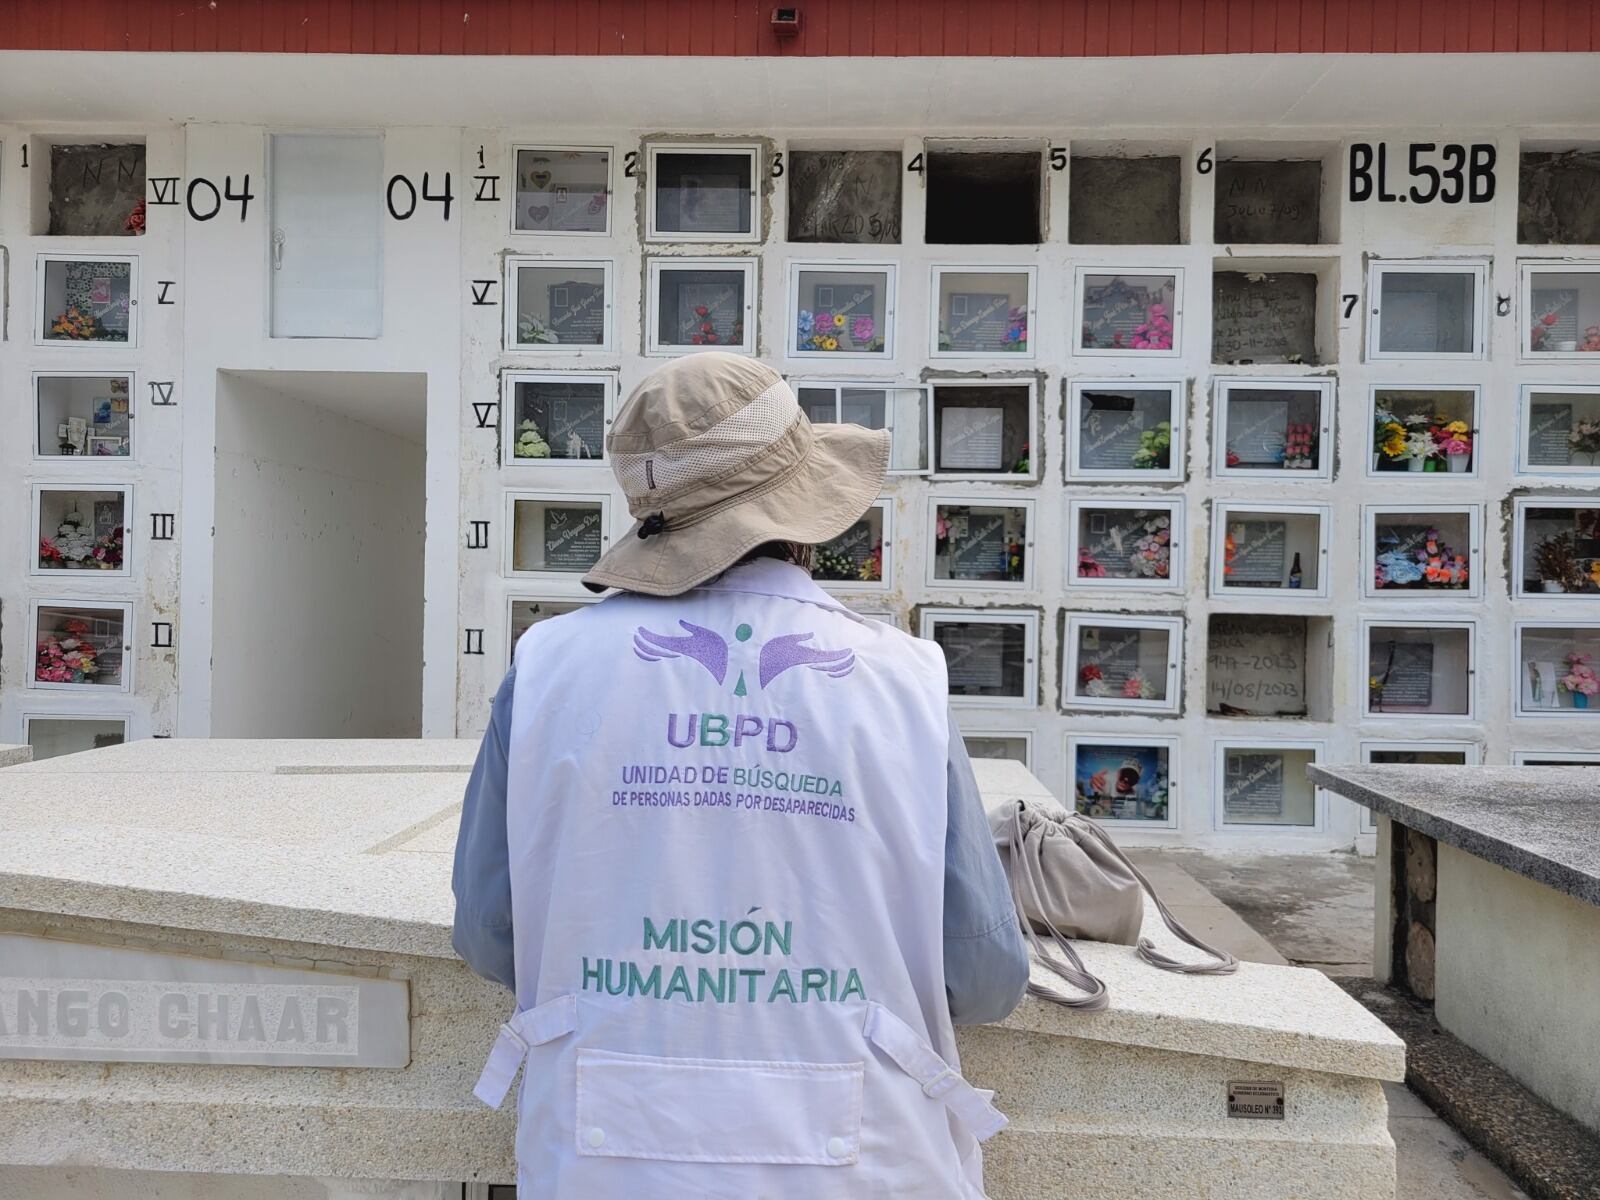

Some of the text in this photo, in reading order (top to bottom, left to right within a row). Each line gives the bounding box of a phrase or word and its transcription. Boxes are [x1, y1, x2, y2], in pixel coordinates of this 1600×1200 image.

[20, 144, 29, 168] 1
[624, 151, 638, 177] 2
[771, 152, 784, 178] 3
[907, 152, 924, 176] 4
[1050, 147, 1067, 171] 5
[1196, 147, 1213, 175] 6
[1349, 142, 1497, 204] BL.53B
[147, 177, 181, 205] VI
[186, 174, 255, 222] 04
[386, 172, 454, 221] 04
[1342, 294, 1358, 318] 7
[150, 513, 175, 540] III
[463, 628, 485, 655] II
[667, 713, 798, 752] UBPD
[622, 764, 843, 797] UNIDAD DE BÚSQUEDA
[612, 791, 855, 822] DE PERSONAS DADAS POR DESAPARECIDAS
[643, 906, 793, 956] MISIÓN
[582, 956, 867, 1004] HUMANITARIA
[0, 989, 350, 1044] NGO CHAAR
[1230, 1104, 1263, 1114] MAUSOLEO
